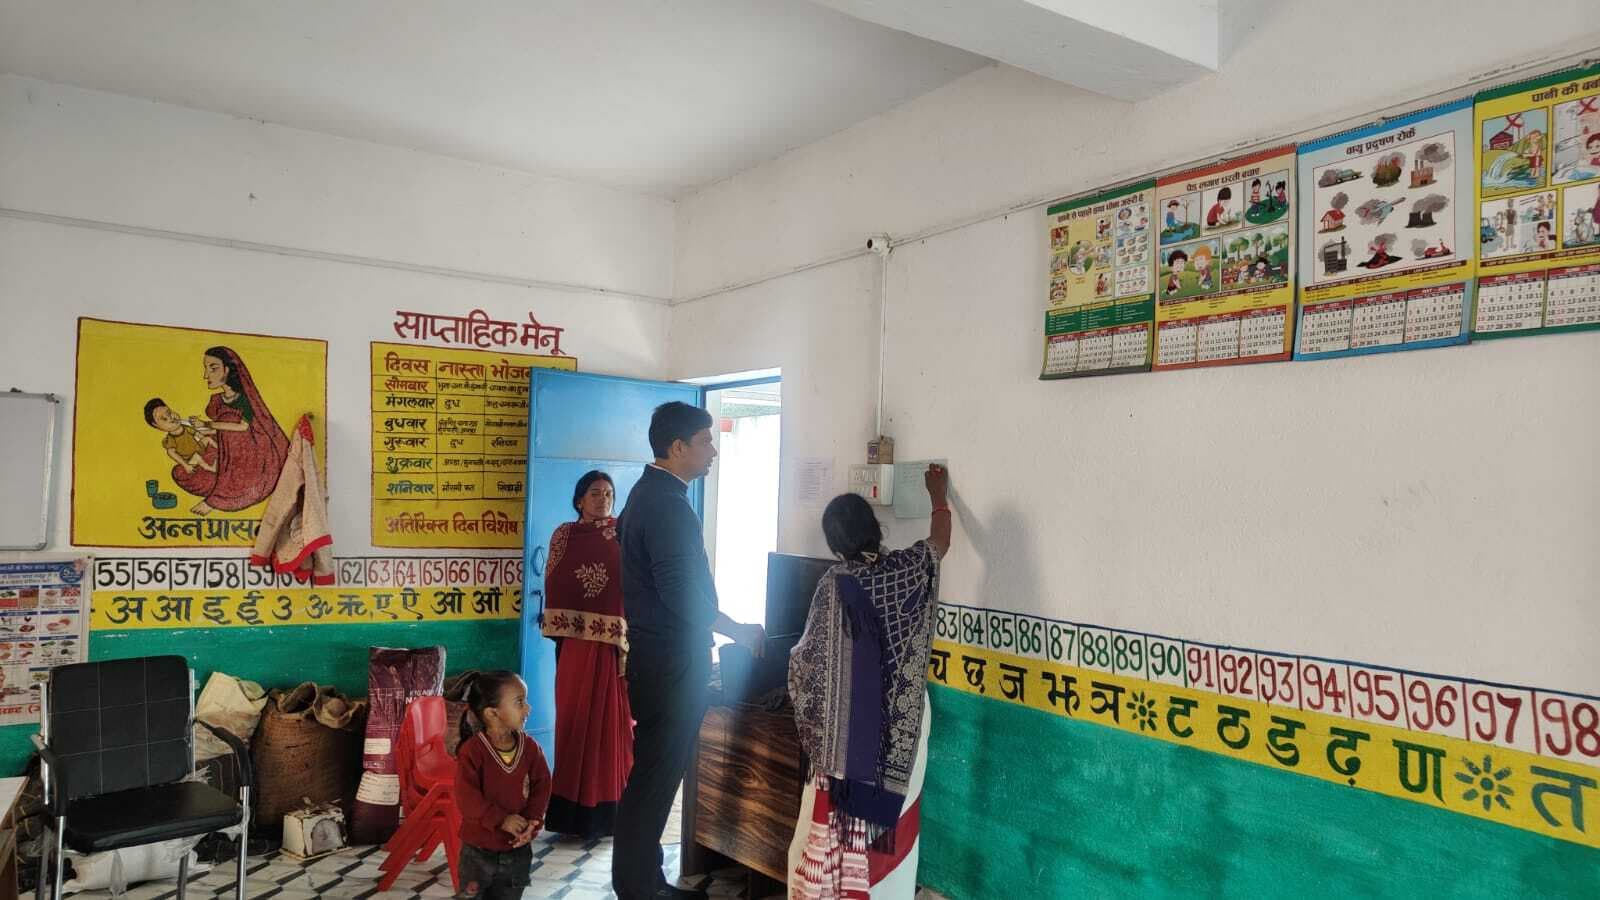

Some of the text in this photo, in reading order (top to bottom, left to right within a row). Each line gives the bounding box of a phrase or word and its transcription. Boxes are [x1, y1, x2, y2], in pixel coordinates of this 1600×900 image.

[394, 309, 517, 348] साप्ताहिक
[384, 352, 431, 375] दिवस
[438, 361, 484, 380] नास्ता
[386, 394, 435, 409] मंगलवार
[384, 418, 428, 432] बुधवार
[386, 456, 433, 474] शुक्रवार
[386, 480, 434, 495] शनिवार
[138, 516, 263, 541] अन्नप्रास
[452, 512, 479, 534] दिन
[98, 561, 130, 586] 55
[136, 561, 168, 584] 56
[174, 562, 202, 586] 57
[207, 561, 240, 588] 58
[248, 563, 275, 586] 59
[341, 560, 364, 584] 62
[368, 560, 390, 584] 63
[396, 560, 417, 587] 64
[422, 560, 444, 585] 65
[448, 560, 470, 583] 66
[476, 560, 497, 584] 67
[105, 596, 147, 624] अ
[151, 596, 193, 623] आ
[202, 596, 232, 624] इ
[236, 590, 264, 624] ई
[372, 593, 398, 620] ए
[430, 587, 466, 614] ओ
[472, 586, 503, 615] औ
[936, 607, 1600, 757] 83 84 85 86 87 88 89 90 91 92 93 94 95 96 97 98
[999, 663, 1028, 702] ज
[1167, 696, 1198, 738] ट
[1216, 704, 1250, 749] ठ
[1266, 716, 1306, 766] ड
[1392, 739, 1446, 806] ण
[1530, 765, 1598, 833] त
